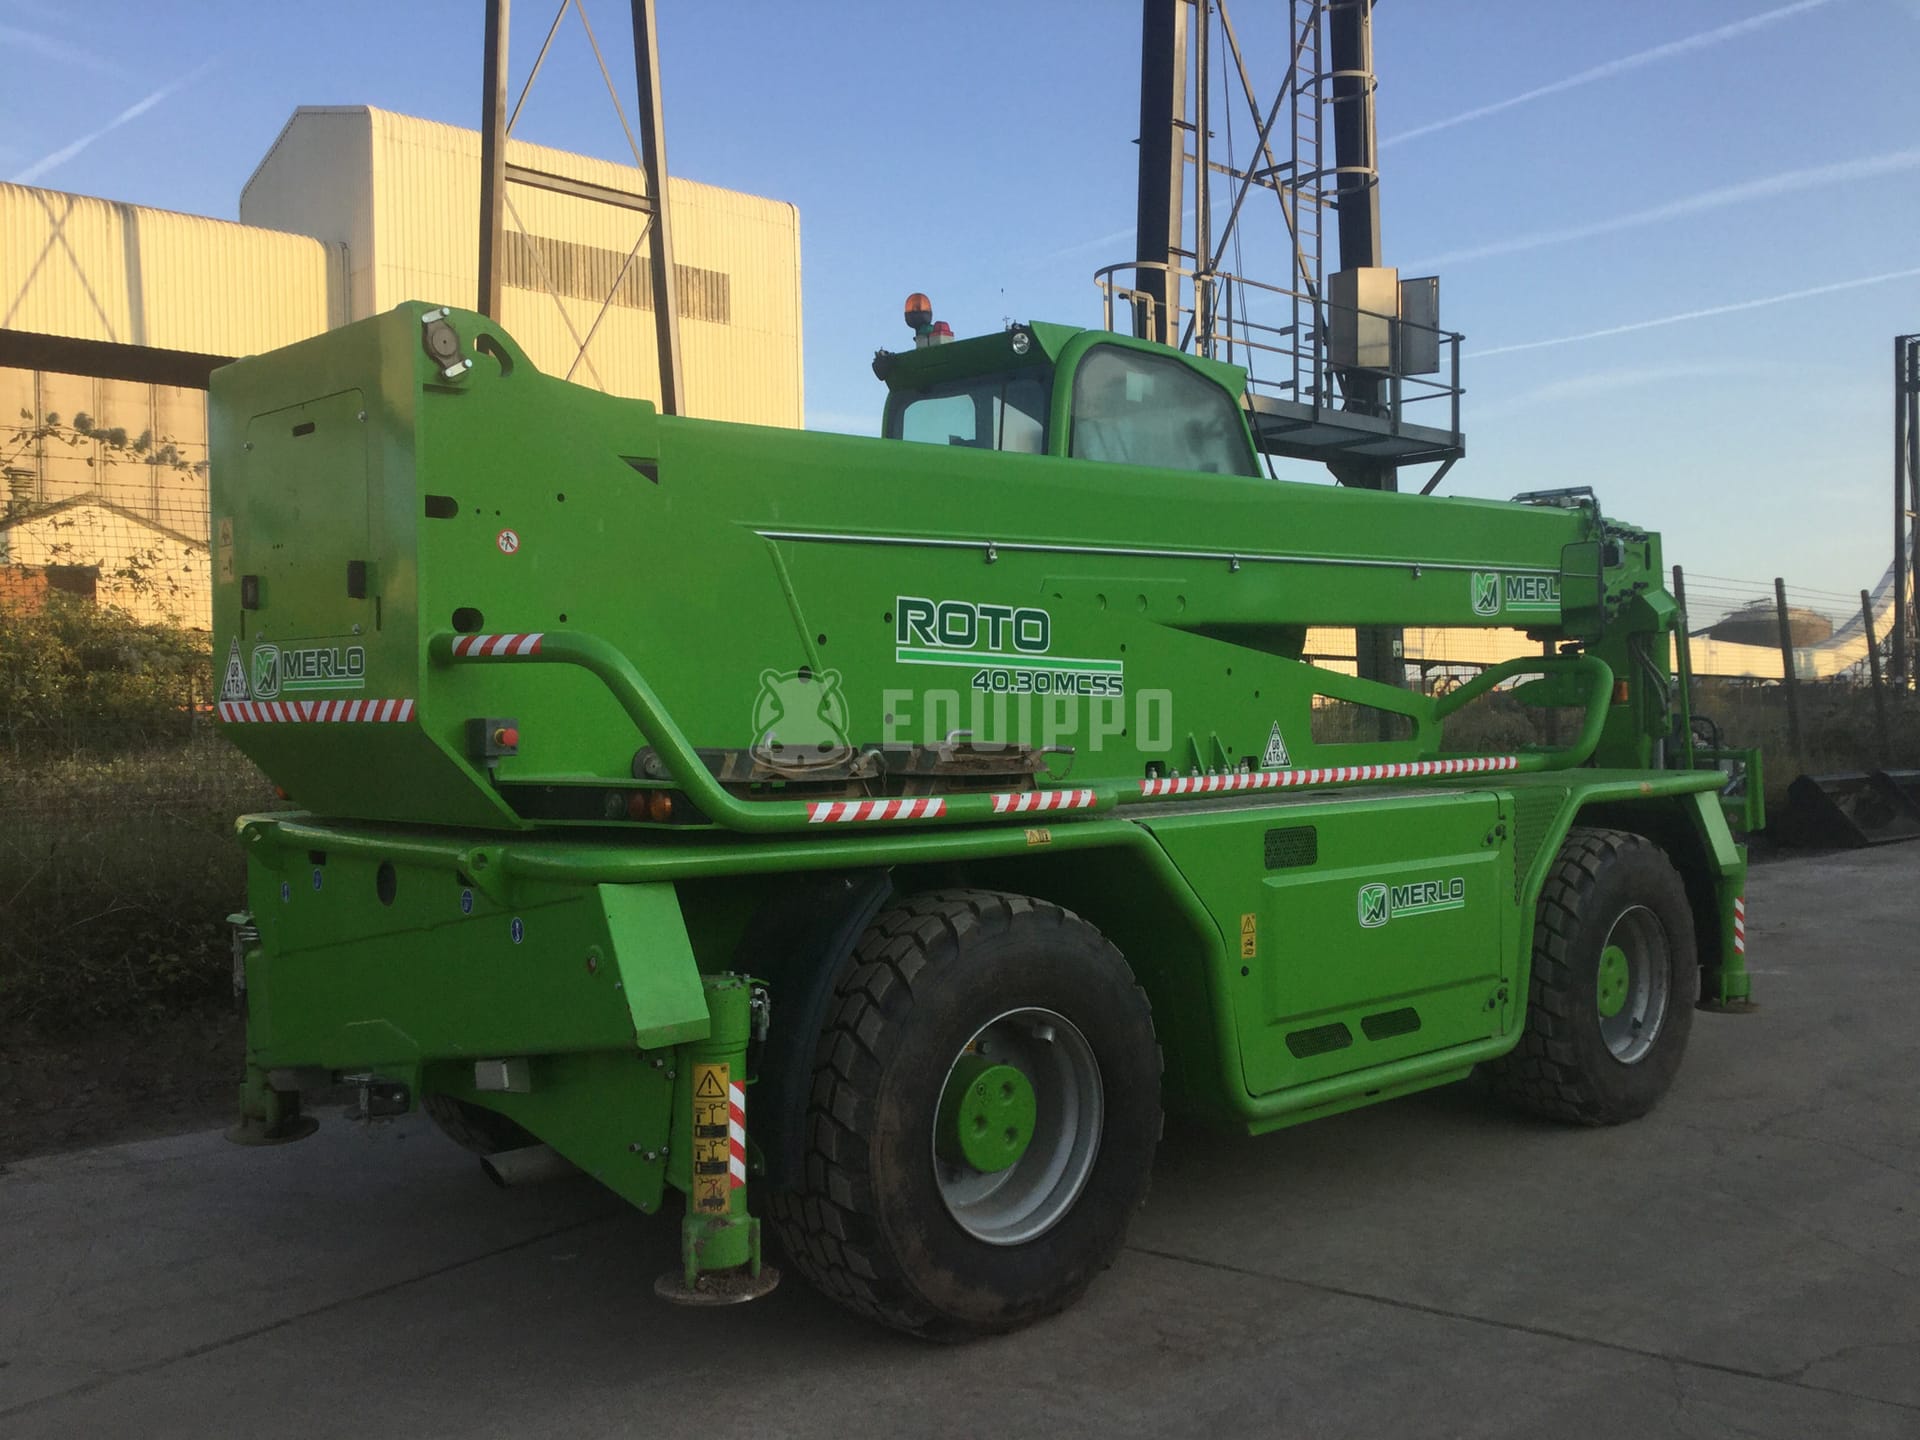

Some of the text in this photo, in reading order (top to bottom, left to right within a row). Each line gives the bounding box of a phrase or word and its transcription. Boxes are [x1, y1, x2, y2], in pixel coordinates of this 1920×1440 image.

[1506, 576, 1561, 601] MERL
[897, 596, 1050, 653] ROTO
[282, 646, 365, 679] MERLO
[972, 670, 1124, 697] 40.30 MCSS
[1391, 877, 1465, 909] MERLO
